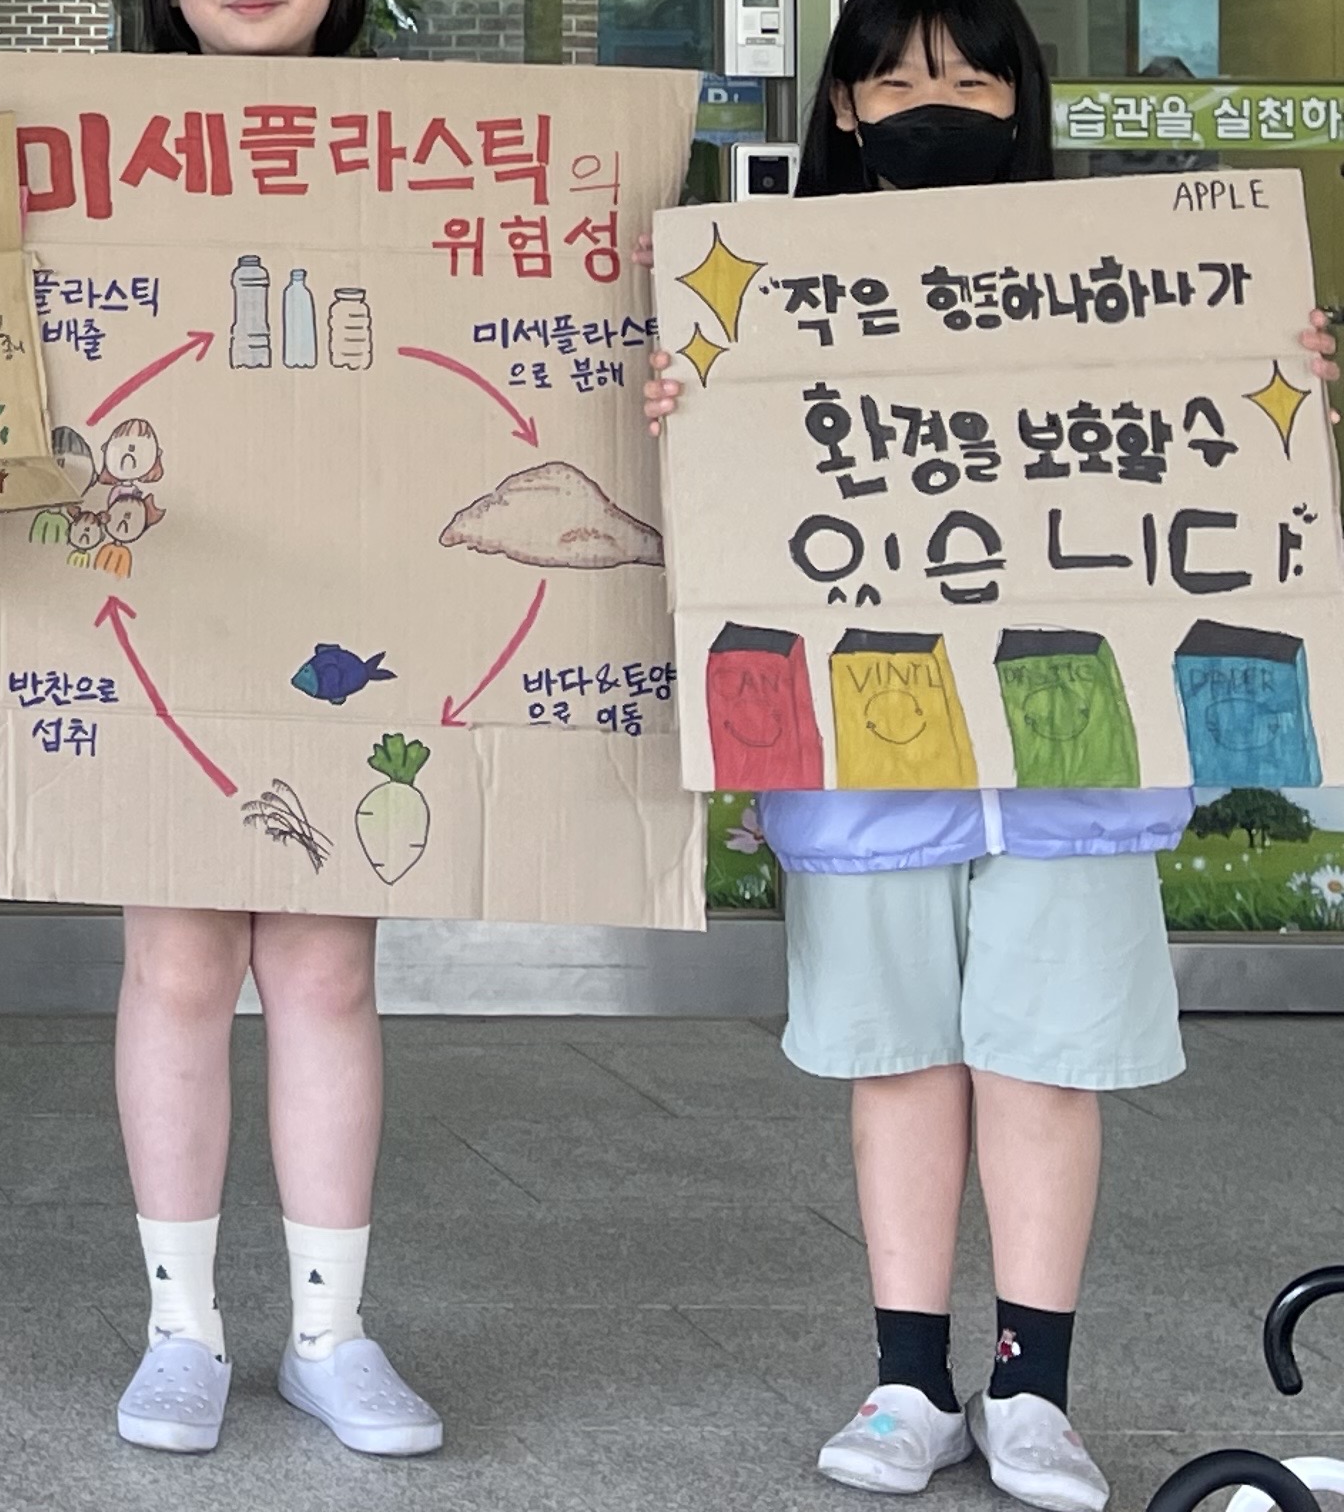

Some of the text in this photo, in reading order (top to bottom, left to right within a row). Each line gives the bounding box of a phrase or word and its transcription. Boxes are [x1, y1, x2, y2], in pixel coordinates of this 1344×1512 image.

[1069, 96, 1193, 140] 습관을
[1173, 179, 1269, 212] APPLE
[432, 213, 621, 283] 위험성
[42, 318, 106, 361] 배출
[509, 357, 625, 393] 으로 분해
[802, 382, 1002, 500] 환경을
[9, 670, 120, 707] 반찬으로
[32, 718, 97, 757] 섭취
[529, 702, 643, 736] 으로 이동
